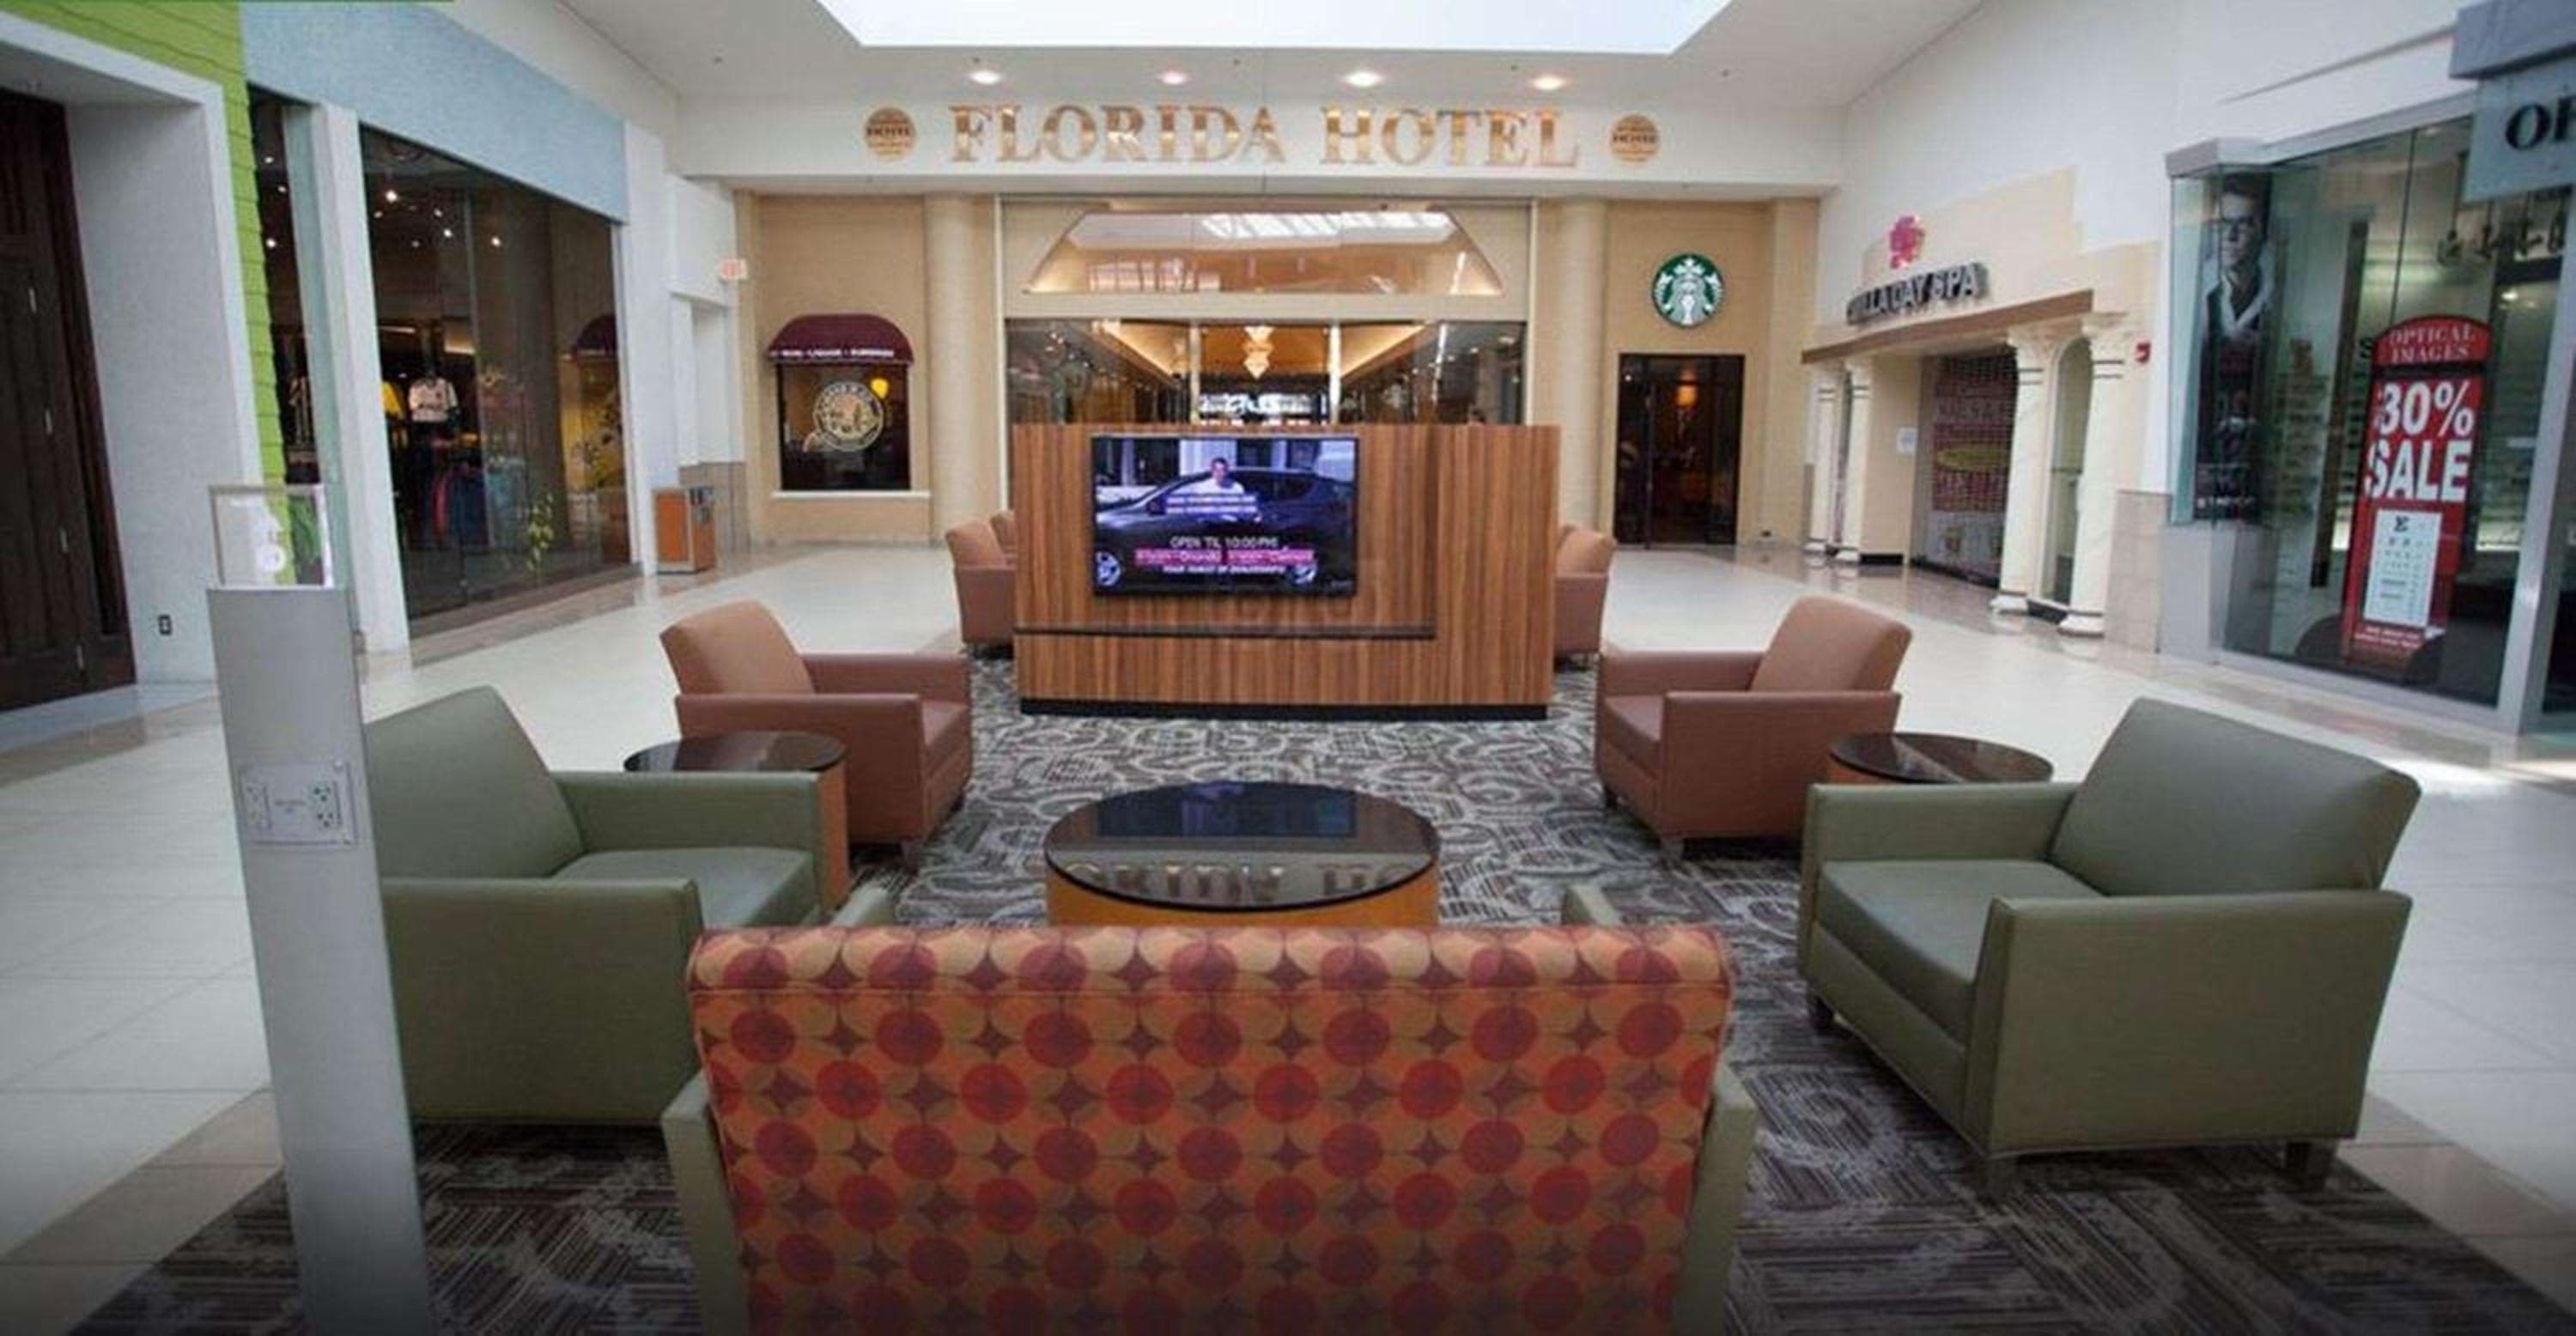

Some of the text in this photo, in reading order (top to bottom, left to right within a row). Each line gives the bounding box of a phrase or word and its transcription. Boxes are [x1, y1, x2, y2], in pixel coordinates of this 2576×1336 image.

[947, 103, 1580, 168] FLORIDA HOTEL
[1930, 261, 1987, 301] SPA
[2389, 324, 2475, 344] OPTICAL
[2391, 344, 2470, 364] IMAGES
[2373, 380, 2475, 437] 30%
[2364, 439, 2473, 502] SALE
